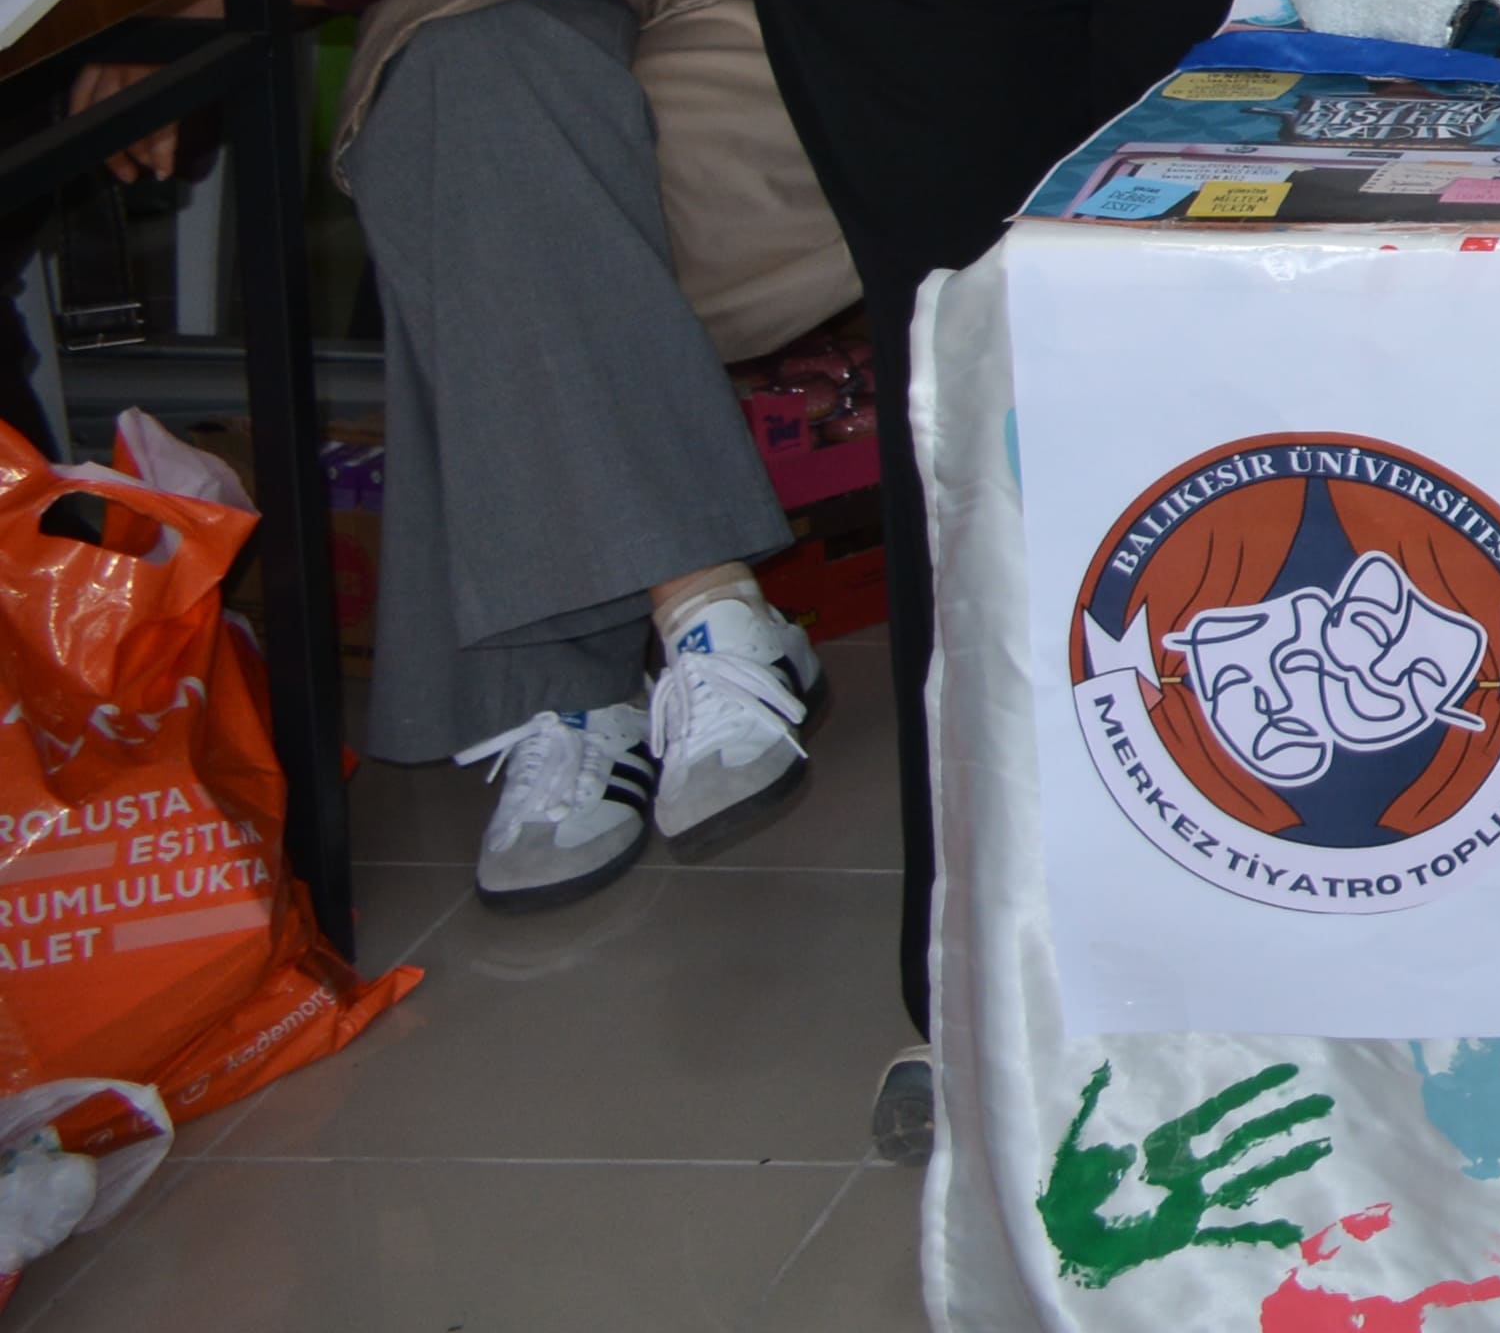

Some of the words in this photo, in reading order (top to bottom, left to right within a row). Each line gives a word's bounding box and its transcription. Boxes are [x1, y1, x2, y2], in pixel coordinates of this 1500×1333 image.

[1111, 449, 1277, 580] BALIKESİR
[0, 786, 192, 844] ROLUŞTA
[1093, 693, 1223, 860] MERKEZ
[1226, 847, 1403, 899] TİYATRO
[0, 857, 272, 929] RUMLULUKTA
[0, 928, 103, 972] ALET
